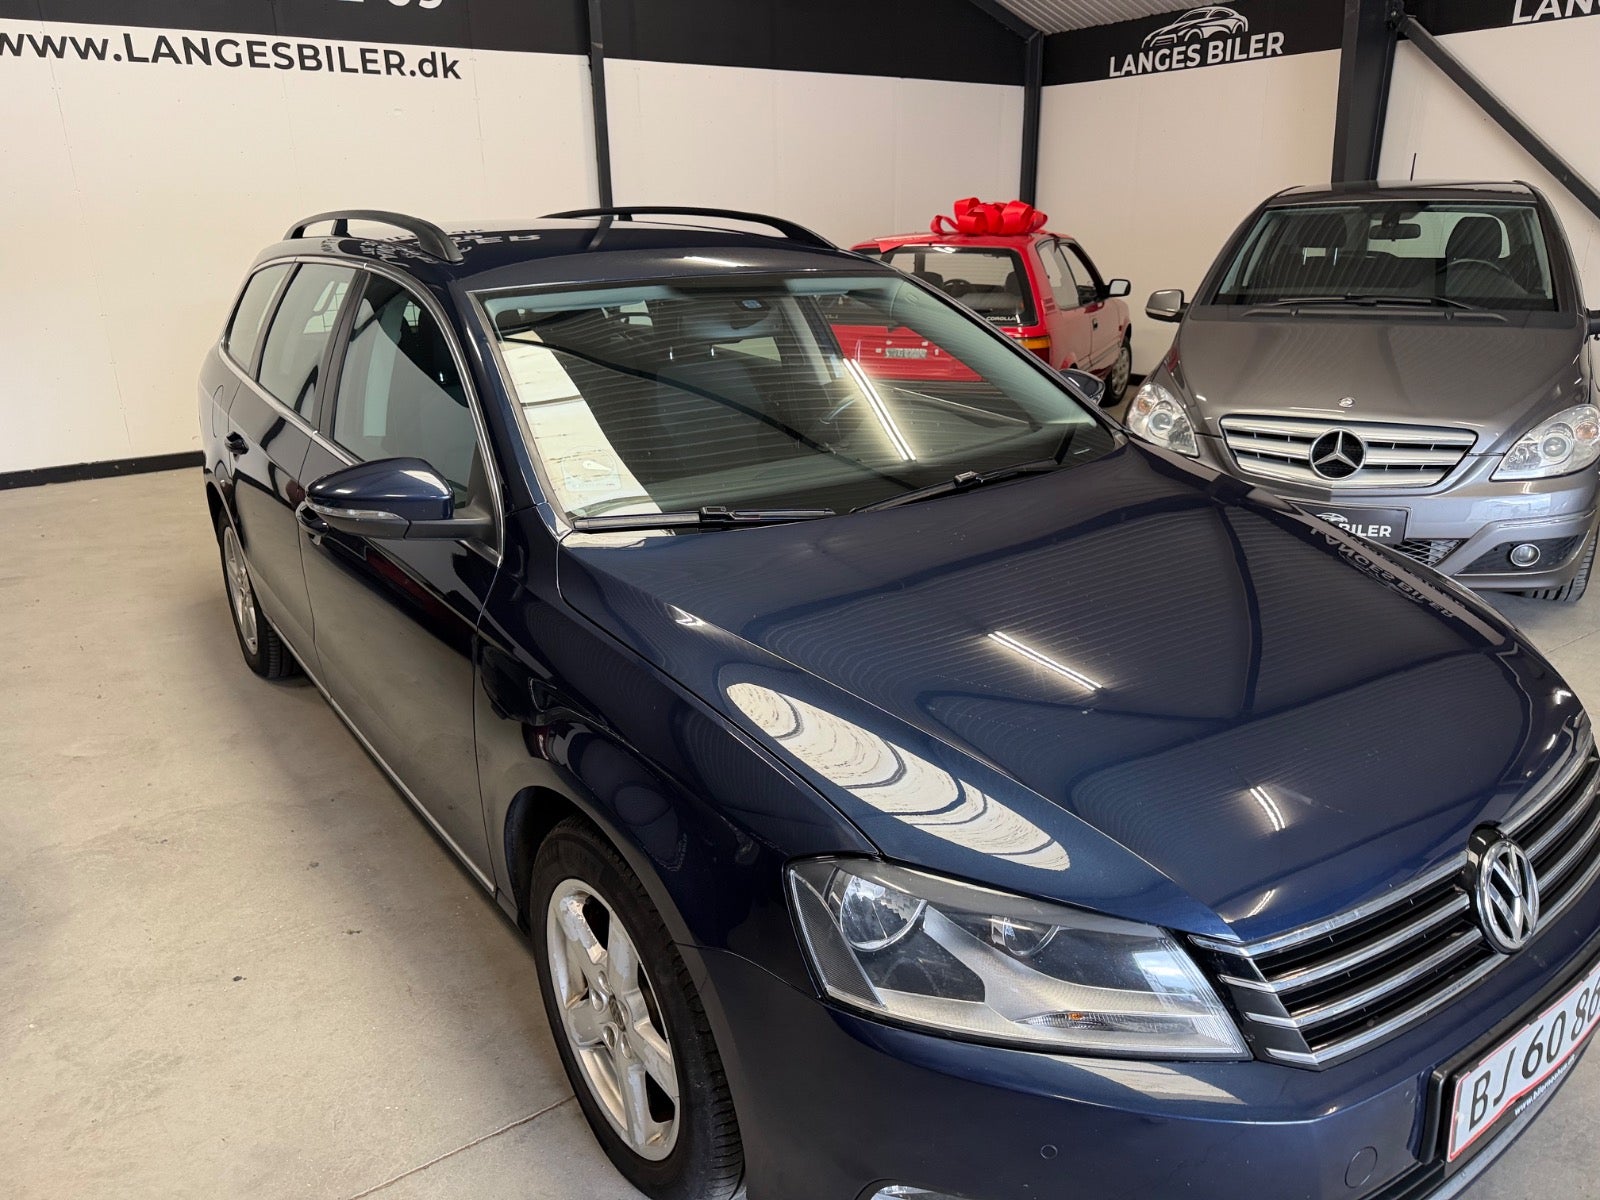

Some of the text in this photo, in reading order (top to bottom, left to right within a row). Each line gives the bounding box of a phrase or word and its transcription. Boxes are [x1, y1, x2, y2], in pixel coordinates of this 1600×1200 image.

[1512, 0, 1600, 24] LAN
[1109, 31, 1285, 78] LANGES BILER
[1469, 1046, 1517, 1132] BJ
[1521, 1010, 1567, 1080] 60
